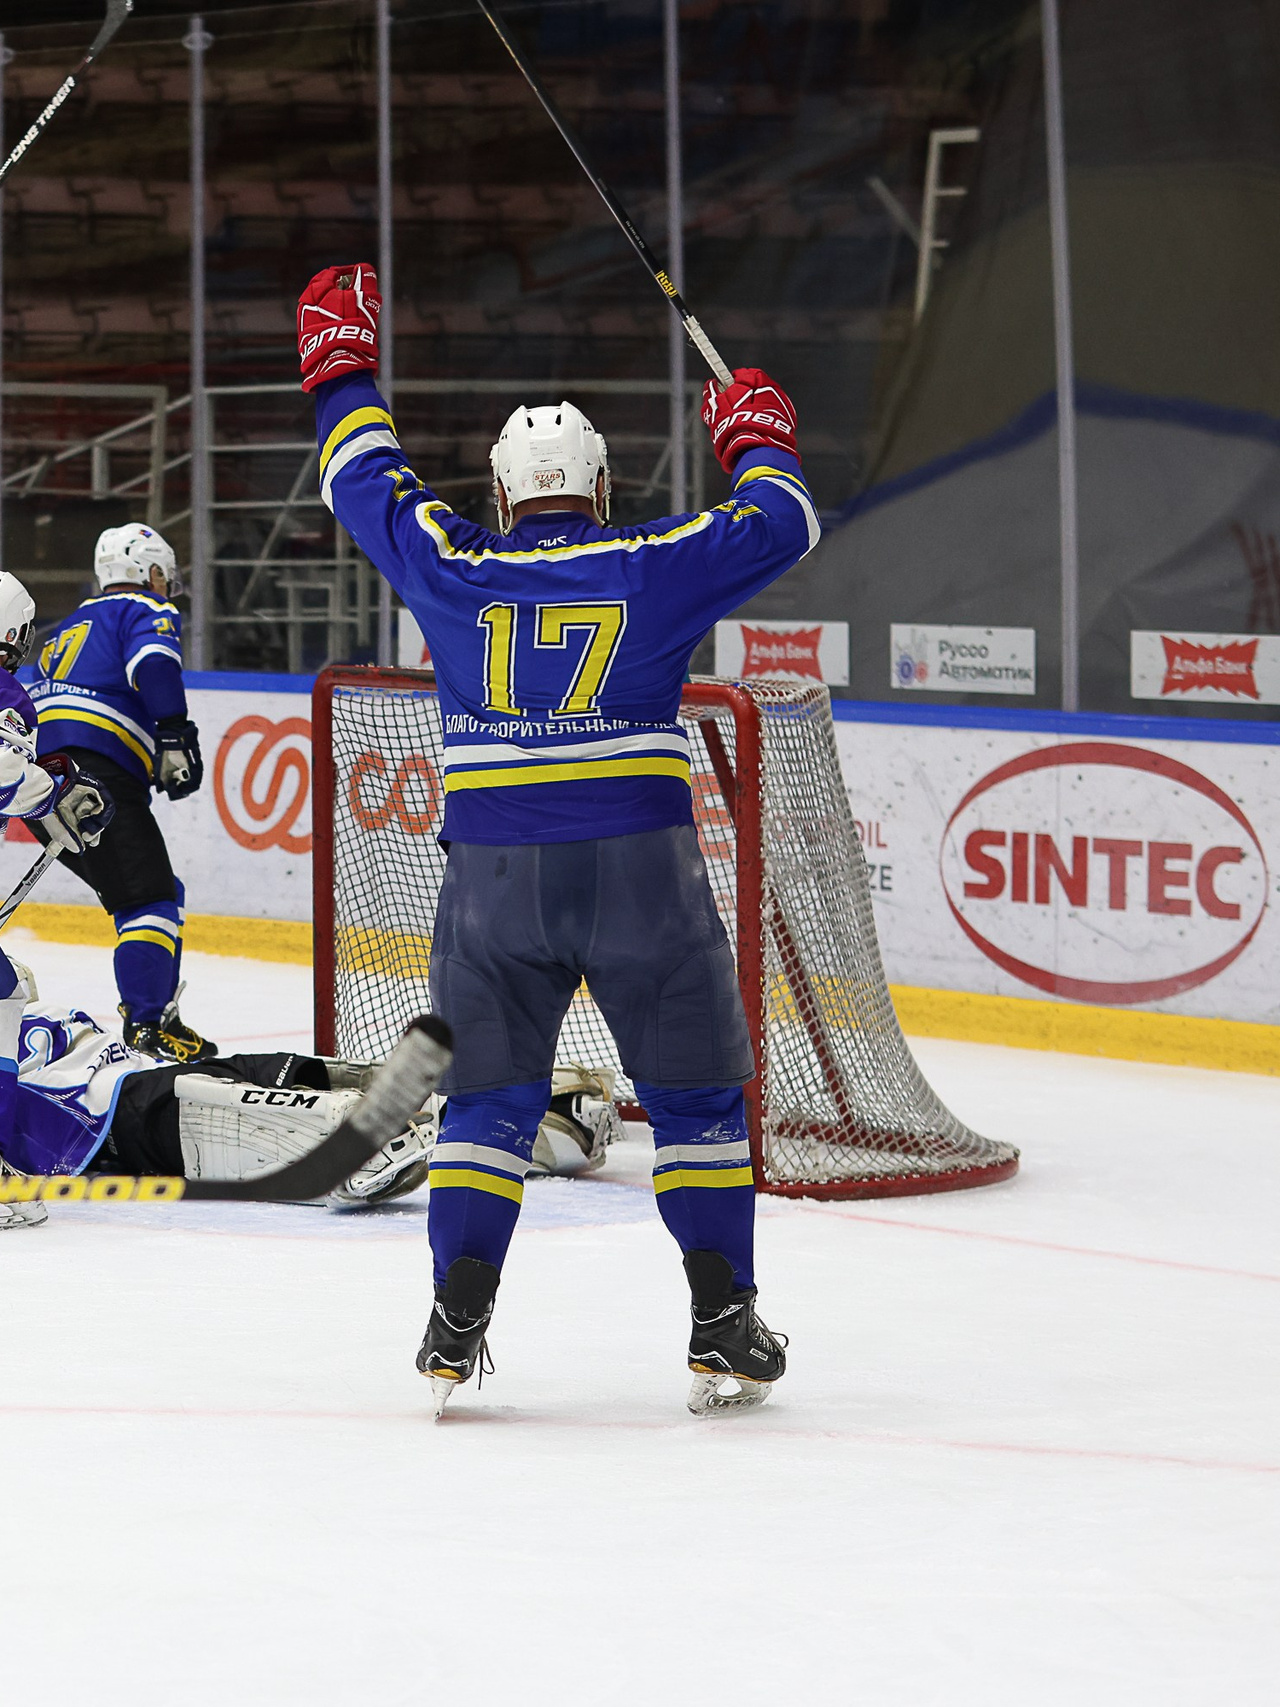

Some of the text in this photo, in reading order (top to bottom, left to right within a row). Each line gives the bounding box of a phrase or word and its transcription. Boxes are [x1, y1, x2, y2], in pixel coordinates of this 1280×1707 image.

[534, 473, 561, 481] STARS
[477, 601, 628, 719] 17
[938, 640, 990, 660] Руссо
[52, 683, 97, 697] ПРОЕК
[963, 829, 1243, 920] SINTEC
[240, 1089, 321, 1109] CCM
